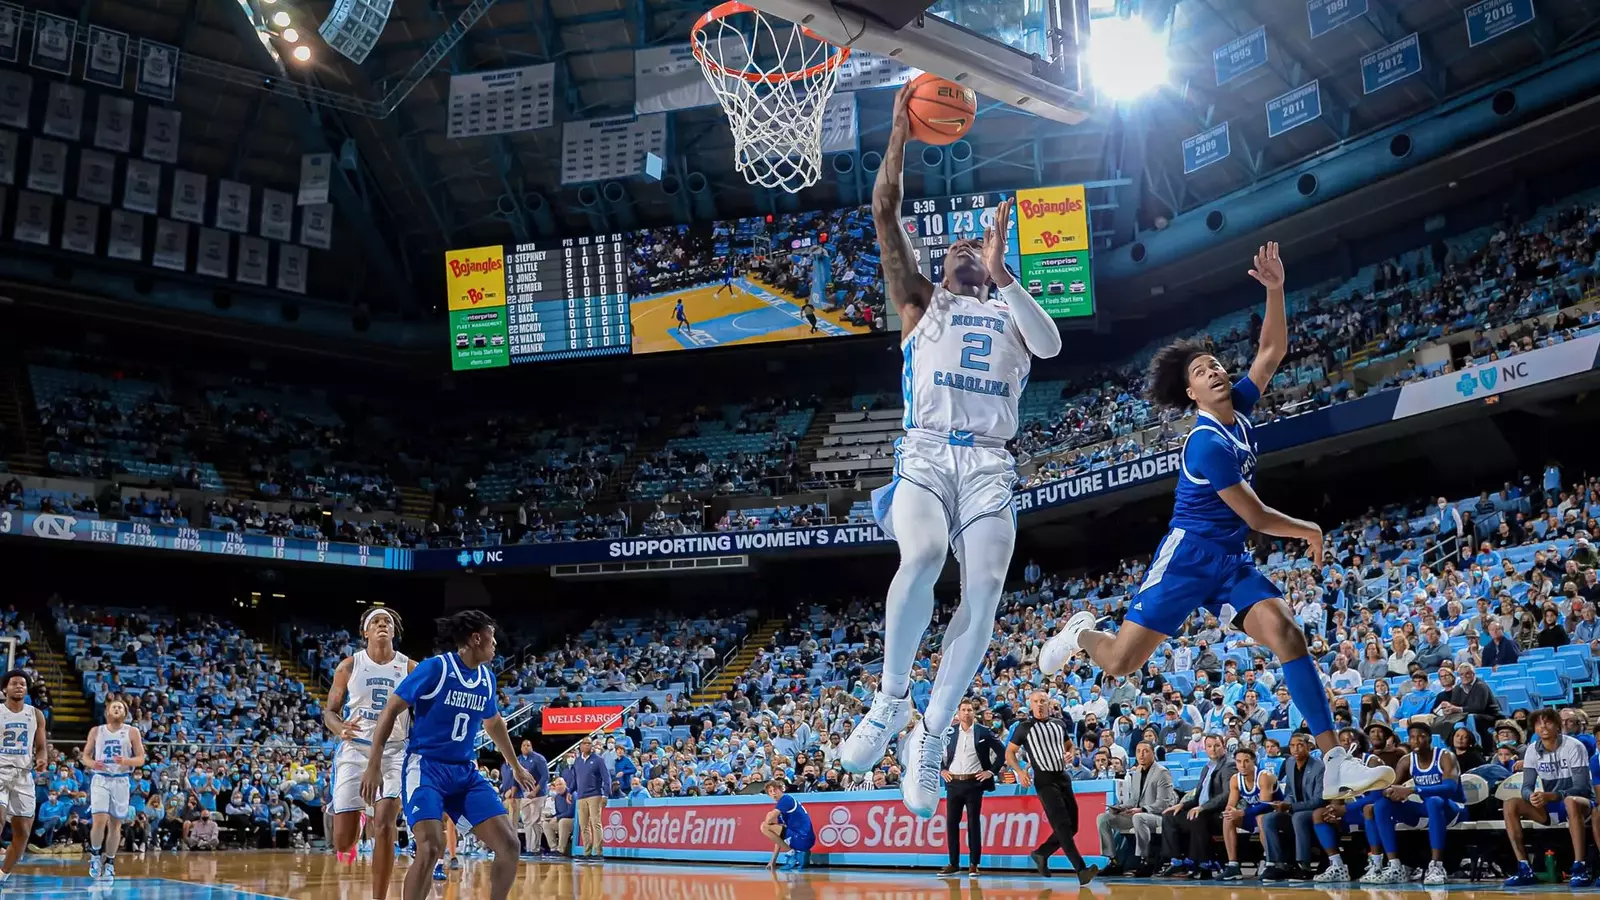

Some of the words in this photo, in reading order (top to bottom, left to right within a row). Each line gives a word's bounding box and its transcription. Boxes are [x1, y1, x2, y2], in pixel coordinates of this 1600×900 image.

[1484, 3, 1514, 24] 2016
[1378, 38, 1416, 61] CHAMPIONS
[1378, 54, 1403, 74] 2012
[937, 86, 970, 103] ELIT
[1282, 99, 1305, 117] 2011
[914, 200, 935, 214] 9:36
[972, 195, 984, 208] 29
[1019, 198, 1082, 219] Bojangles
[923, 214, 943, 236] 10
[953, 211, 974, 233] 23
[516, 243, 535, 252] PLAYER
[562, 239, 573, 247] PTS
[579, 237, 589, 245] REB
[595, 235, 605, 243] AST
[612, 233, 622, 242] FLS
[1040, 231, 1060, 249] Bo
[507, 255, 512, 264] 0
[565, 248, 571, 258] 0
[597, 244, 604, 254] 2
[614, 242, 620, 252] 0
[1033, 257, 1077, 266] enterprise
[449, 257, 502, 279] Bojangles
[508, 265, 512, 274] 1
[516, 262, 538, 273] BATTLE
[566, 258, 572, 268] 3
[582, 256, 588, 266] 0
[615, 253, 621, 263] 0
[508, 275, 513, 284] 3
[516, 272, 537, 283] JONES
[566, 268, 572, 278] 2
[599, 265, 605, 274] 0
[615, 263, 622, 273] 0
[1047, 266, 1083, 274] MANAGEMENT
[509, 285, 514, 294] 4
[516, 282, 542, 293] PEMBER
[567, 278, 573, 288] 2
[583, 276, 589, 286] 0
[600, 275, 606, 284] 0
[616, 273, 622, 283] 0
[467, 288, 483, 304] Bo
[507, 295, 517, 304] 22
[518, 293, 533, 303] JUDE
[568, 289, 573, 298] 3
[584, 287, 590, 296] 0
[601, 285, 606, 295] 0
[617, 284, 623, 293] 0
[510, 305, 515, 314] 2
[518, 303, 534, 313] LOVE
[569, 299, 574, 308] 0
[585, 297, 590, 307] 3
[601, 295, 607, 305] 2
[617, 294, 623, 303] 0
[510, 315, 516, 324] 5
[518, 313, 538, 323] BACOT
[569, 309, 575, 318] 6
[585, 307, 591, 317] 2
[602, 305, 607, 315] 0
[618, 304, 624, 313] 0
[950, 314, 1005, 334] NORTH
[509, 325, 519, 334] 22
[520, 323, 542, 333] MCKOY
[570, 319, 575, 328] 0
[586, 317, 592, 327] 0
[602, 316, 608, 325] 2
[509, 335, 519, 344] 24
[520, 333, 545, 343] WALTON
[571, 329, 576, 339] 0
[603, 326, 609, 335] 0
[619, 324, 625, 334] 0
[520, 343, 543, 354] MANEK
[571, 340, 576, 349] 6
[587, 338, 593, 348] 3
[604, 336, 609, 346] 0
[620, 335, 626, 344] 0
[960, 332, 992, 372] 2
[1502, 362, 1529, 382] NC
[933, 371, 1010, 397] CAROLINA
[1037, 473, 1103, 505] FUTURE
[1108, 453, 1183, 487] LEADER
[91, 531, 110, 542] FLS:
[132, 523, 151, 535] FG%
[226, 532, 244, 543] FT%
[317, 541, 329, 551] AST
[359, 545, 370, 556] STL
[609, 535, 731, 558] SUPPORTING
[735, 529, 830, 550] WOMEN'S
[123, 532, 158, 548] 53.3%
[174, 537, 201, 551] 80%
[221, 542, 247, 555] 75%
[272, 547, 284, 559] 16
[318, 552, 325, 562] 5
[360, 555, 367, 566] 0
[487, 550, 503, 562] NC
[366, 677, 395, 688] NORTH
[371, 689, 388, 710] 5
[444, 689, 487, 711] ASHEVILLE
[451, 712, 470, 742] 0
[548, 715, 582, 724] WELLS
[3, 730, 28, 747] 24
[103, 746, 122, 758] 45
